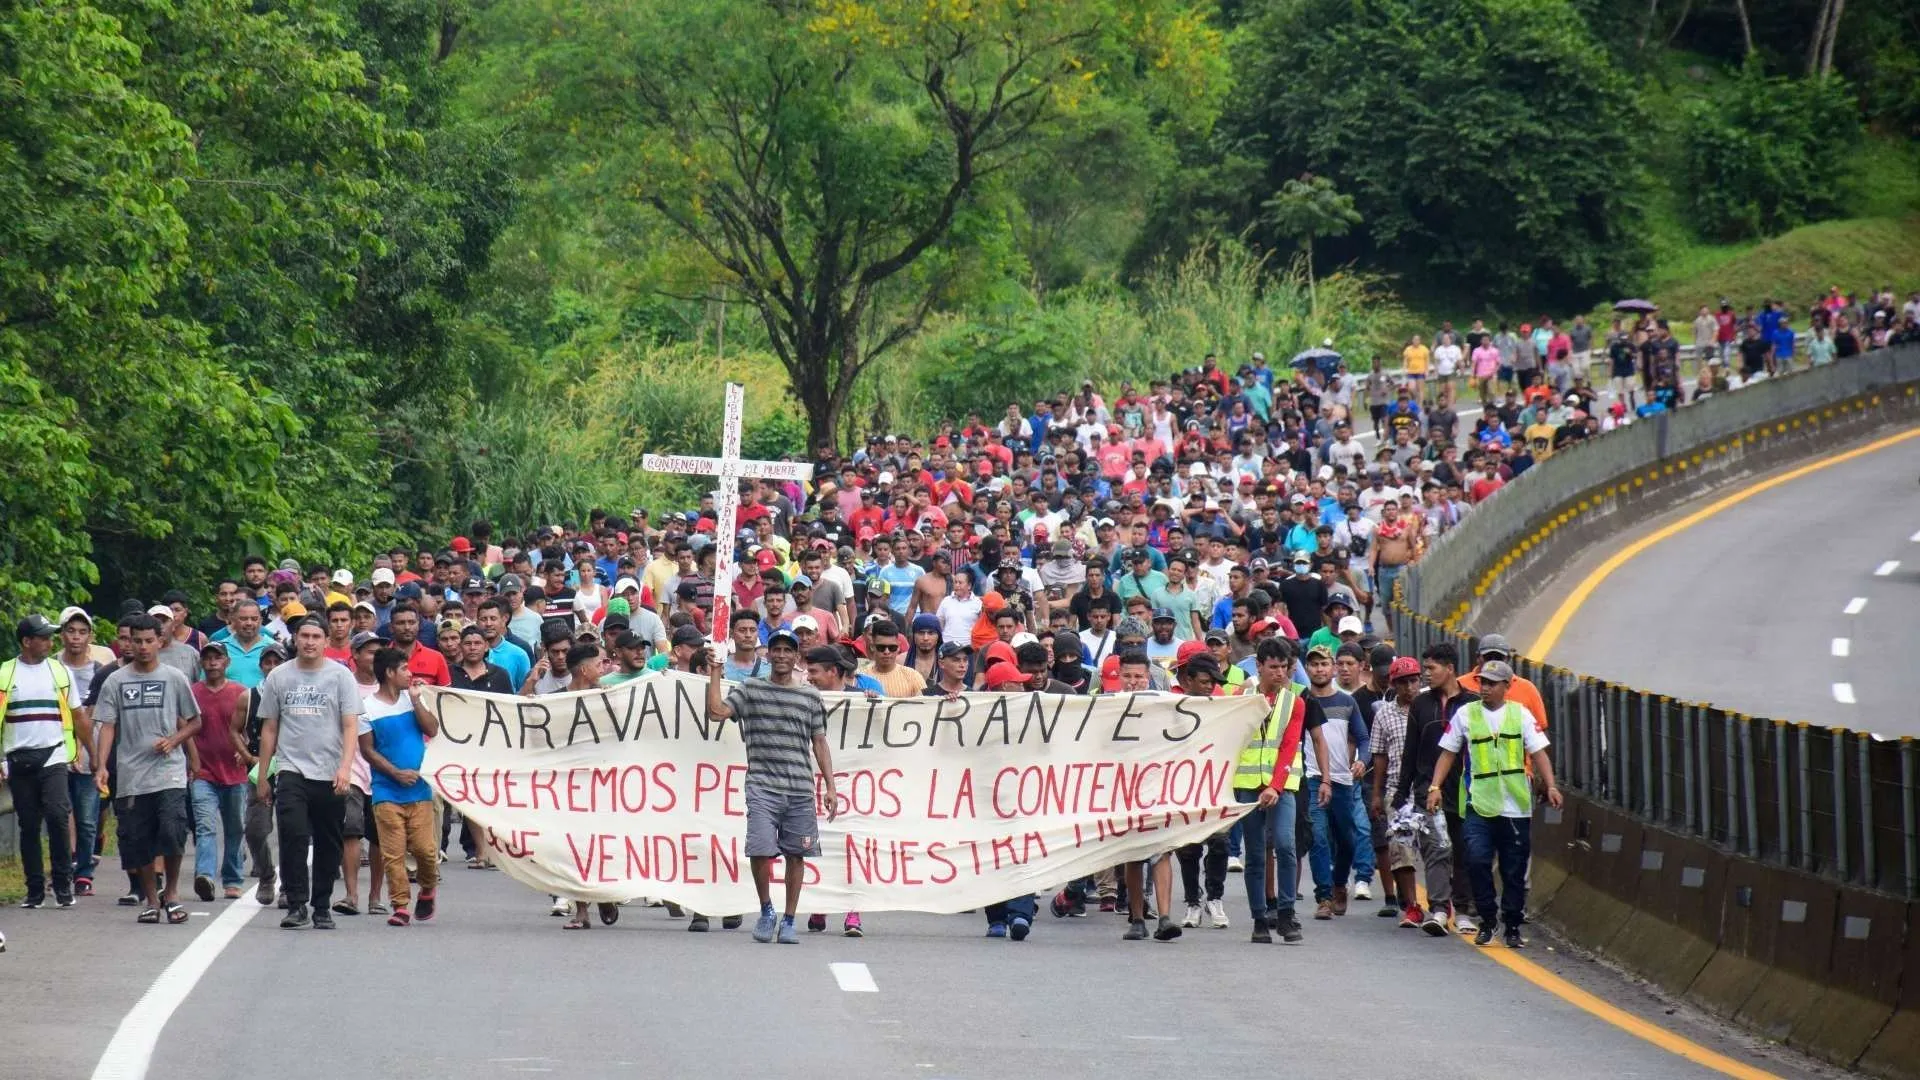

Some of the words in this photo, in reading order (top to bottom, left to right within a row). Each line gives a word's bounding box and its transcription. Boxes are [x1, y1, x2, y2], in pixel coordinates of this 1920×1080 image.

[722, 462, 736, 472] ES
[763, 464, 797, 476] MUERTE
[433, 761, 677, 814] QUEREMOS
[694, 761, 903, 818] PEISOS
[927, 767, 976, 820] LA
[992, 743, 1230, 819] CONTENCIÓN
[566, 832, 740, 884] VENDEN
[845, 831, 1048, 886] NUESTRA
